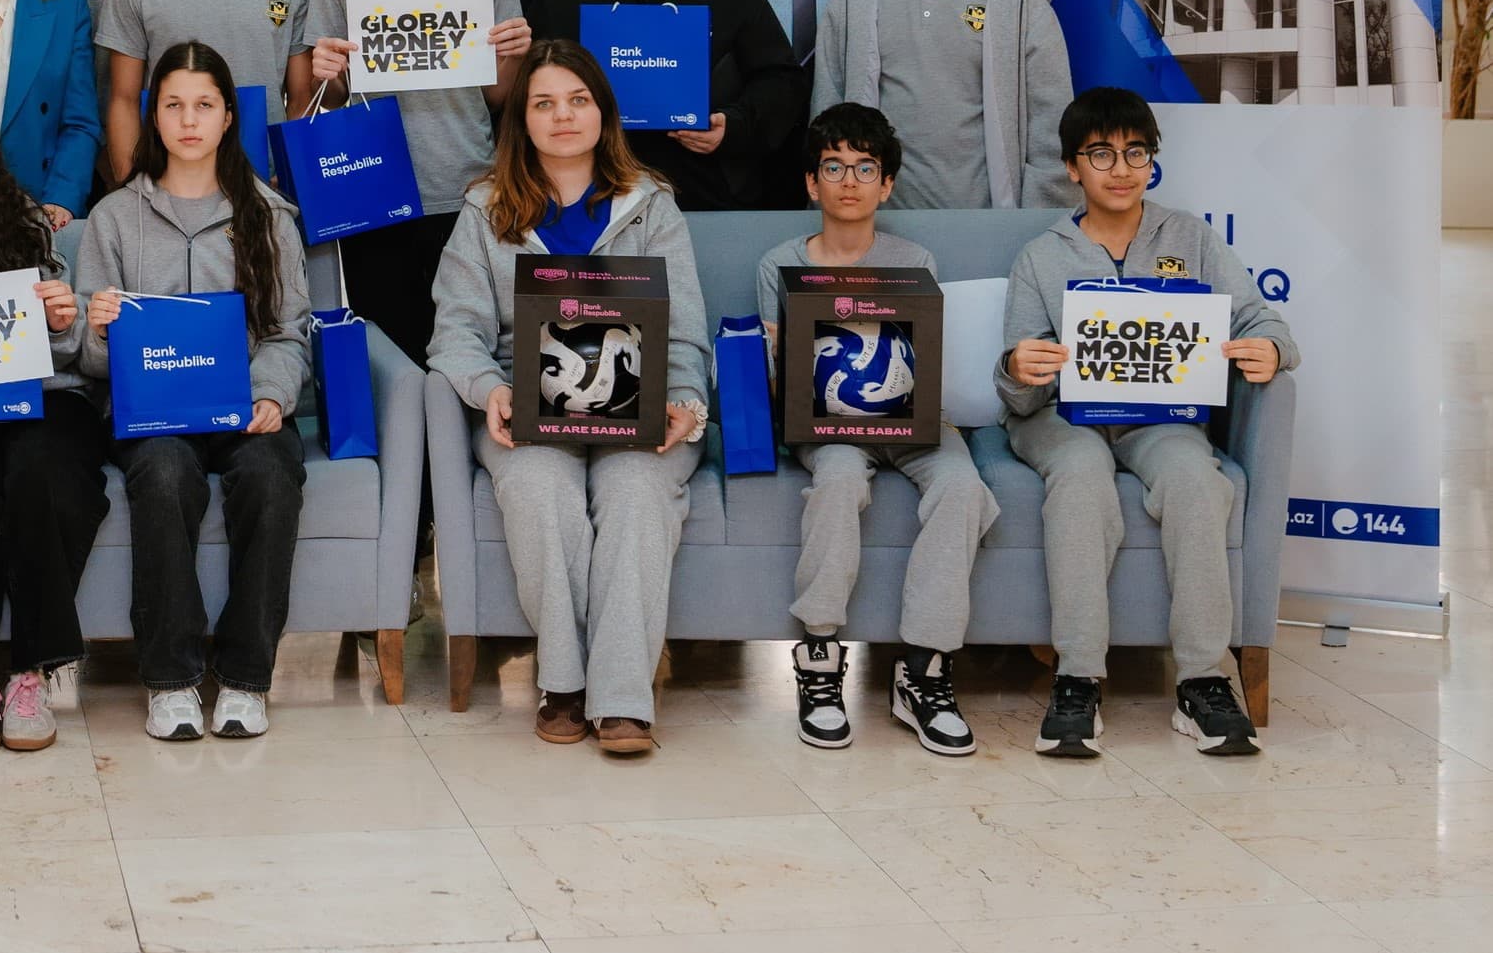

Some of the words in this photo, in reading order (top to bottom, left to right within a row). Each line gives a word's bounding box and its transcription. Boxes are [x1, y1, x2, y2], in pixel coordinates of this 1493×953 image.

[361, 11, 477, 34] GLOBAL
[362, 30, 466, 54] MONEY
[611, 47, 642, 56] Bank
[362, 51, 450, 73] WEEK
[611, 58, 677, 69] Respublika
[319, 152, 349, 167] Bank
[322, 155, 382, 179] Respublika
[1077, 319, 1209, 343] GLOBAL
[143, 346, 176, 358] Bank
[1076, 340, 1196, 362] MONEY
[144, 356, 215, 371] Respublika
[1076, 361, 1174, 383] WEEK
[539, 425, 560, 433] WE
[562, 425, 589, 434] ARE
[591, 426, 636, 435] SABAH
[814, 427, 836, 435] WE
[838, 427, 864, 435] ARE
[867, 427, 912, 436] SABAH
[1362, 513, 1405, 536] 144
